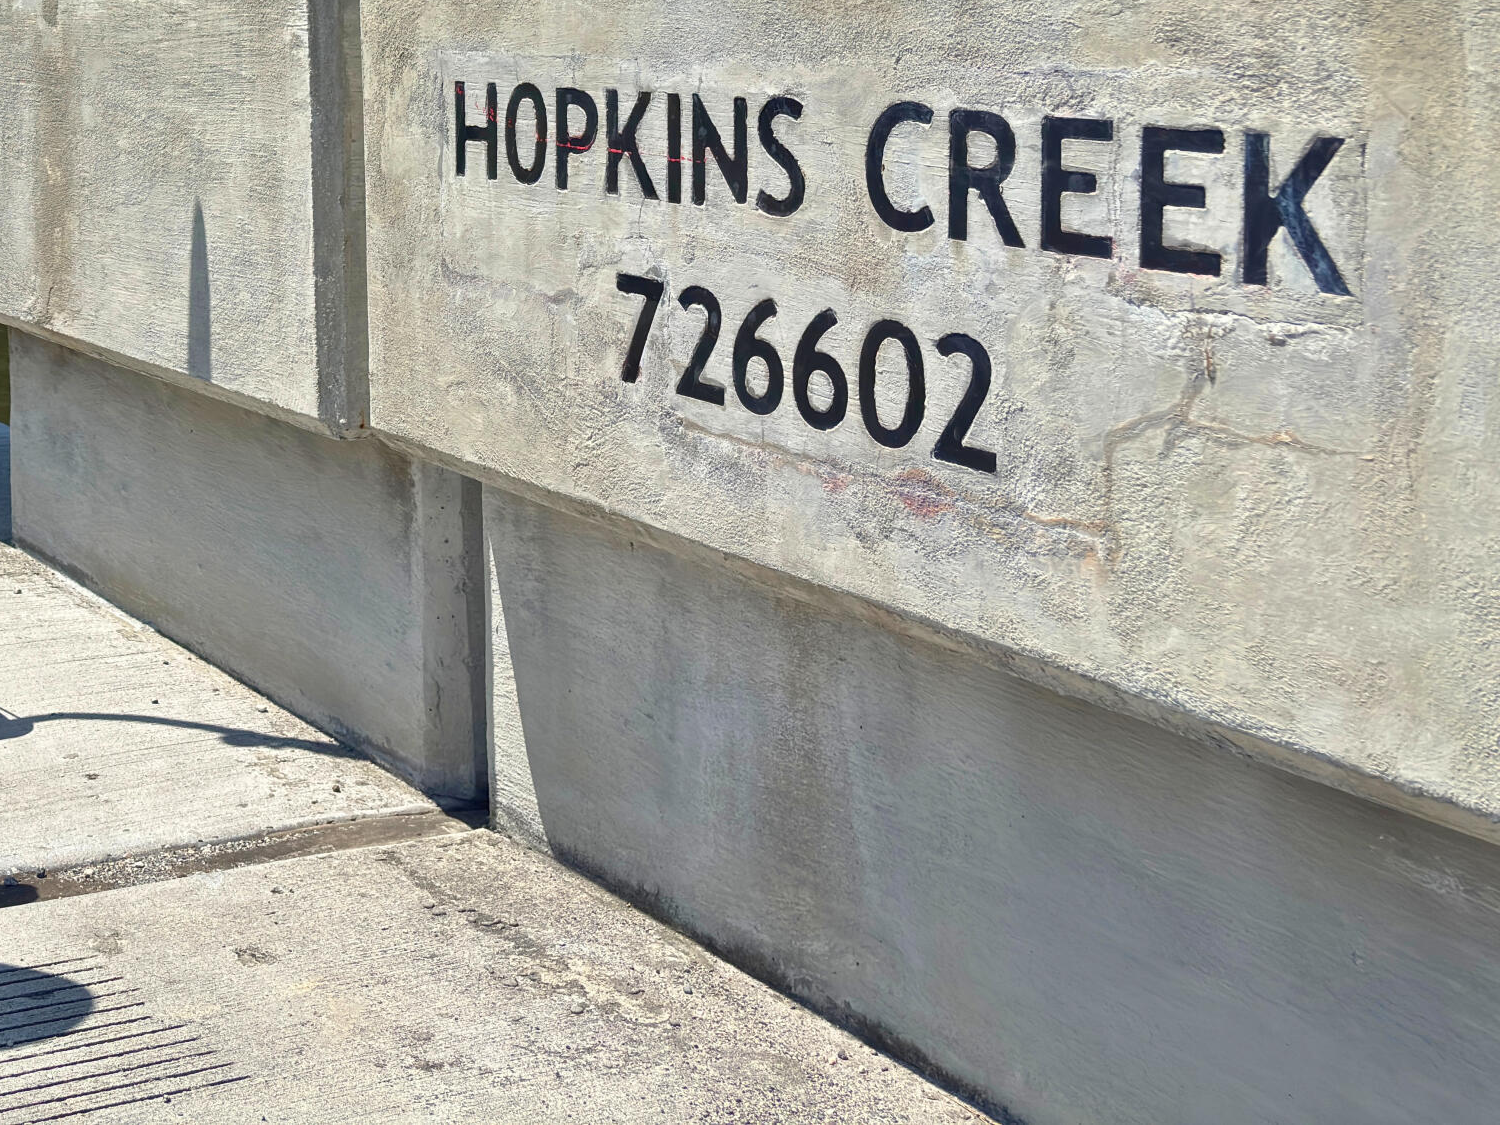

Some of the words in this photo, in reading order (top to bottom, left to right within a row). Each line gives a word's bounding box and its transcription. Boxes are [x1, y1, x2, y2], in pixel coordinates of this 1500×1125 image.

[454, 80, 806, 217] HOPKINS
[865, 101, 1354, 298] CREEK
[615, 273, 998, 474] 726602
